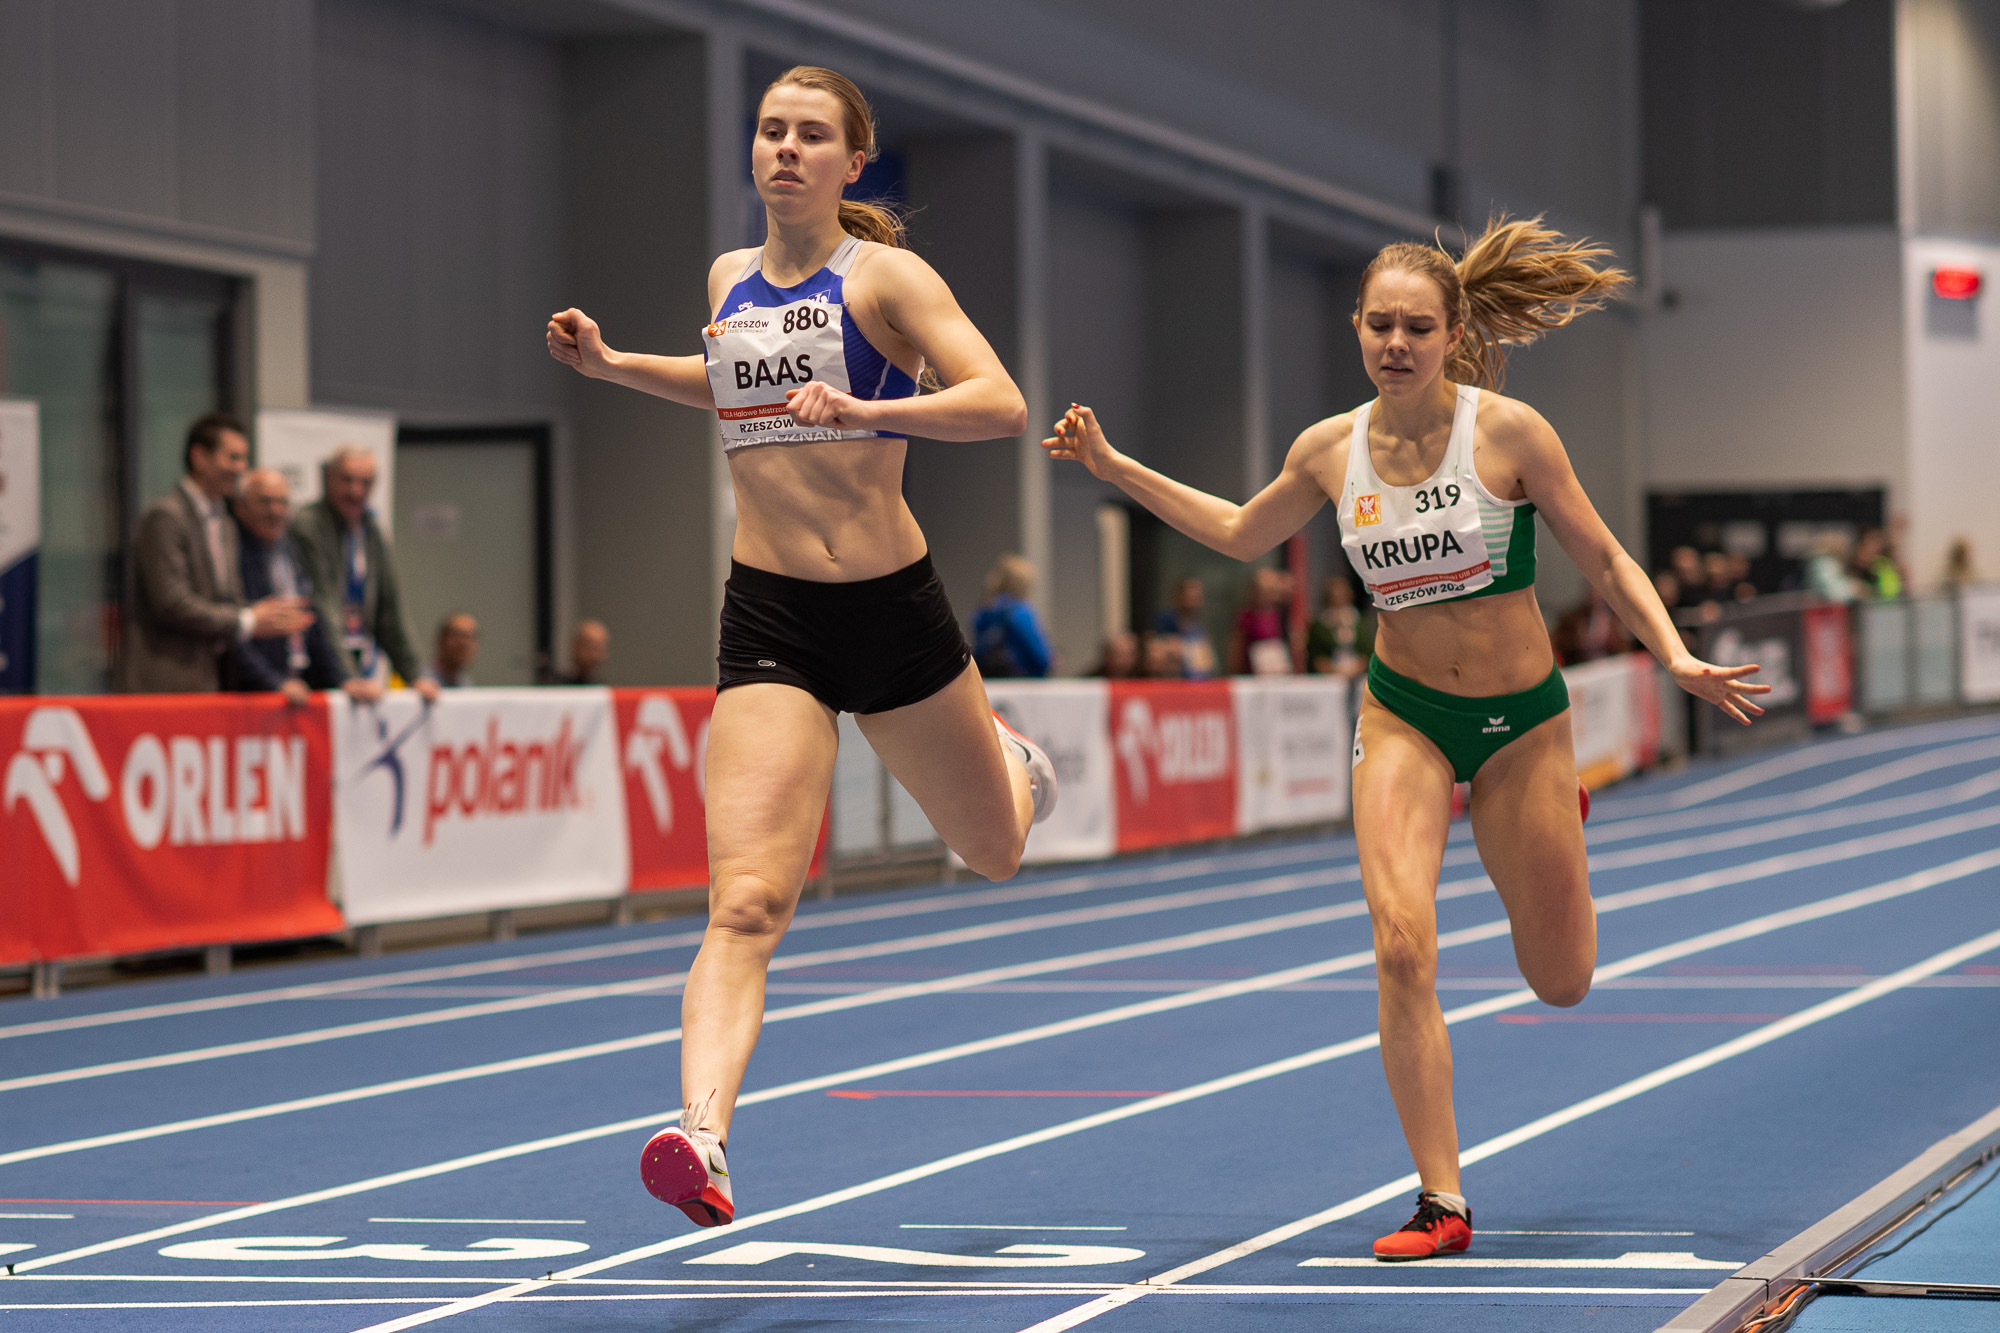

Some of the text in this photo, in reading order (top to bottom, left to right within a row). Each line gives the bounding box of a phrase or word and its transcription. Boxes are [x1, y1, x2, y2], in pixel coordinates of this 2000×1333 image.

[727, 319, 770, 329] rzeszów
[783, 306, 829, 334] 880
[734, 354, 813, 390] BAAS
[733, 409, 758, 418] Halowe
[739, 416, 795, 433] RZESZÓW
[1415, 484, 1461, 514] 319
[1361, 530, 1464, 570] KRUPA
[1380, 584, 1399, 593] lowe
[1399, 575, 1439, 589] Mistrzostwa
[1471, 564, 1485, 574] U20
[1482, 725, 1511, 734] erima
[121, 732, 308, 851] ORLEN
[423, 710, 588, 850] polanik
[157, 1235, 592, 1262] 3
[682, 1241, 1147, 1268] 2
